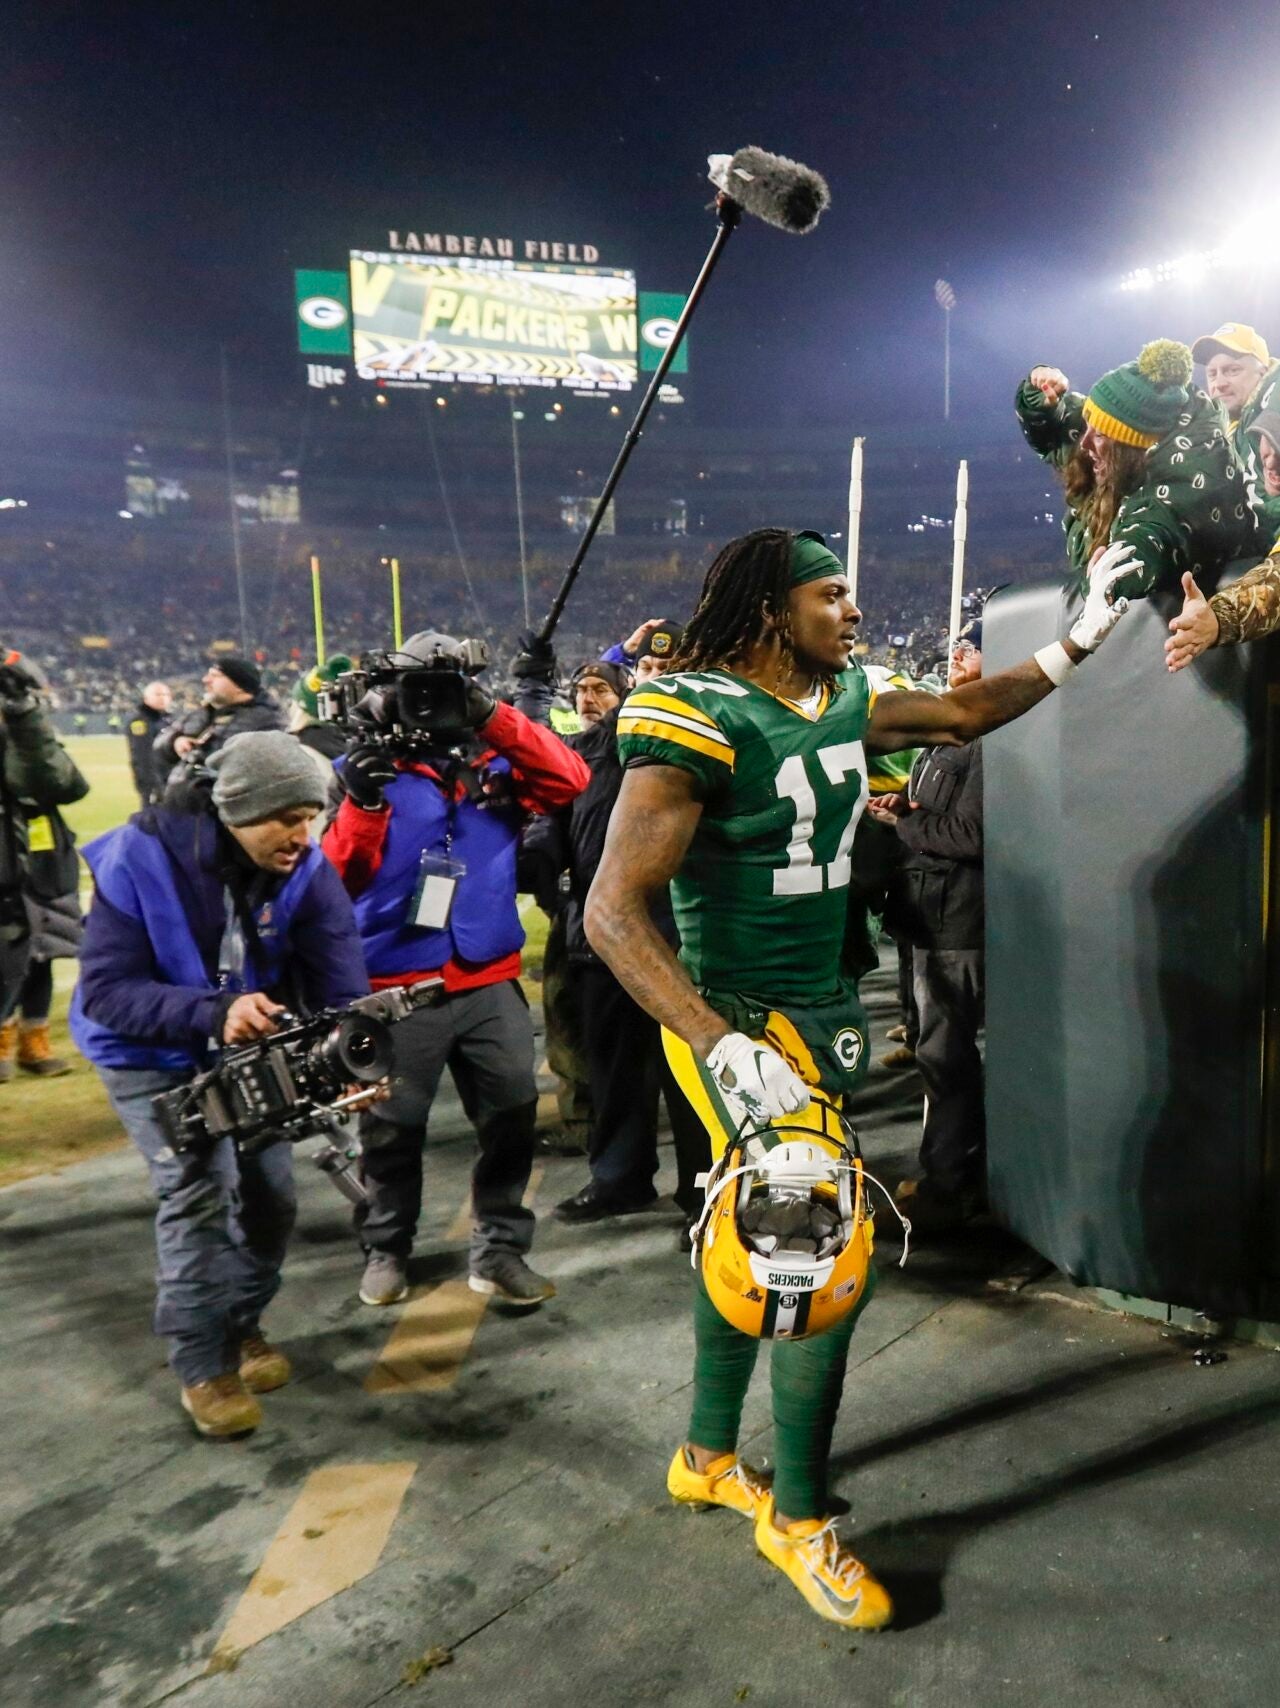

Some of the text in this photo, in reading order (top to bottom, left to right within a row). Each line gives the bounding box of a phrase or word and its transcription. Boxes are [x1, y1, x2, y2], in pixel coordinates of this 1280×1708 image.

[388, 230, 514, 258] LAMBEAU
[525, 240, 600, 263] FIELD
[425, 288, 592, 352] PACKERS
[772, 740, 869, 896] 17
[833, 1031, 860, 1069] G
[768, 1272, 814, 1287] PACKERS
